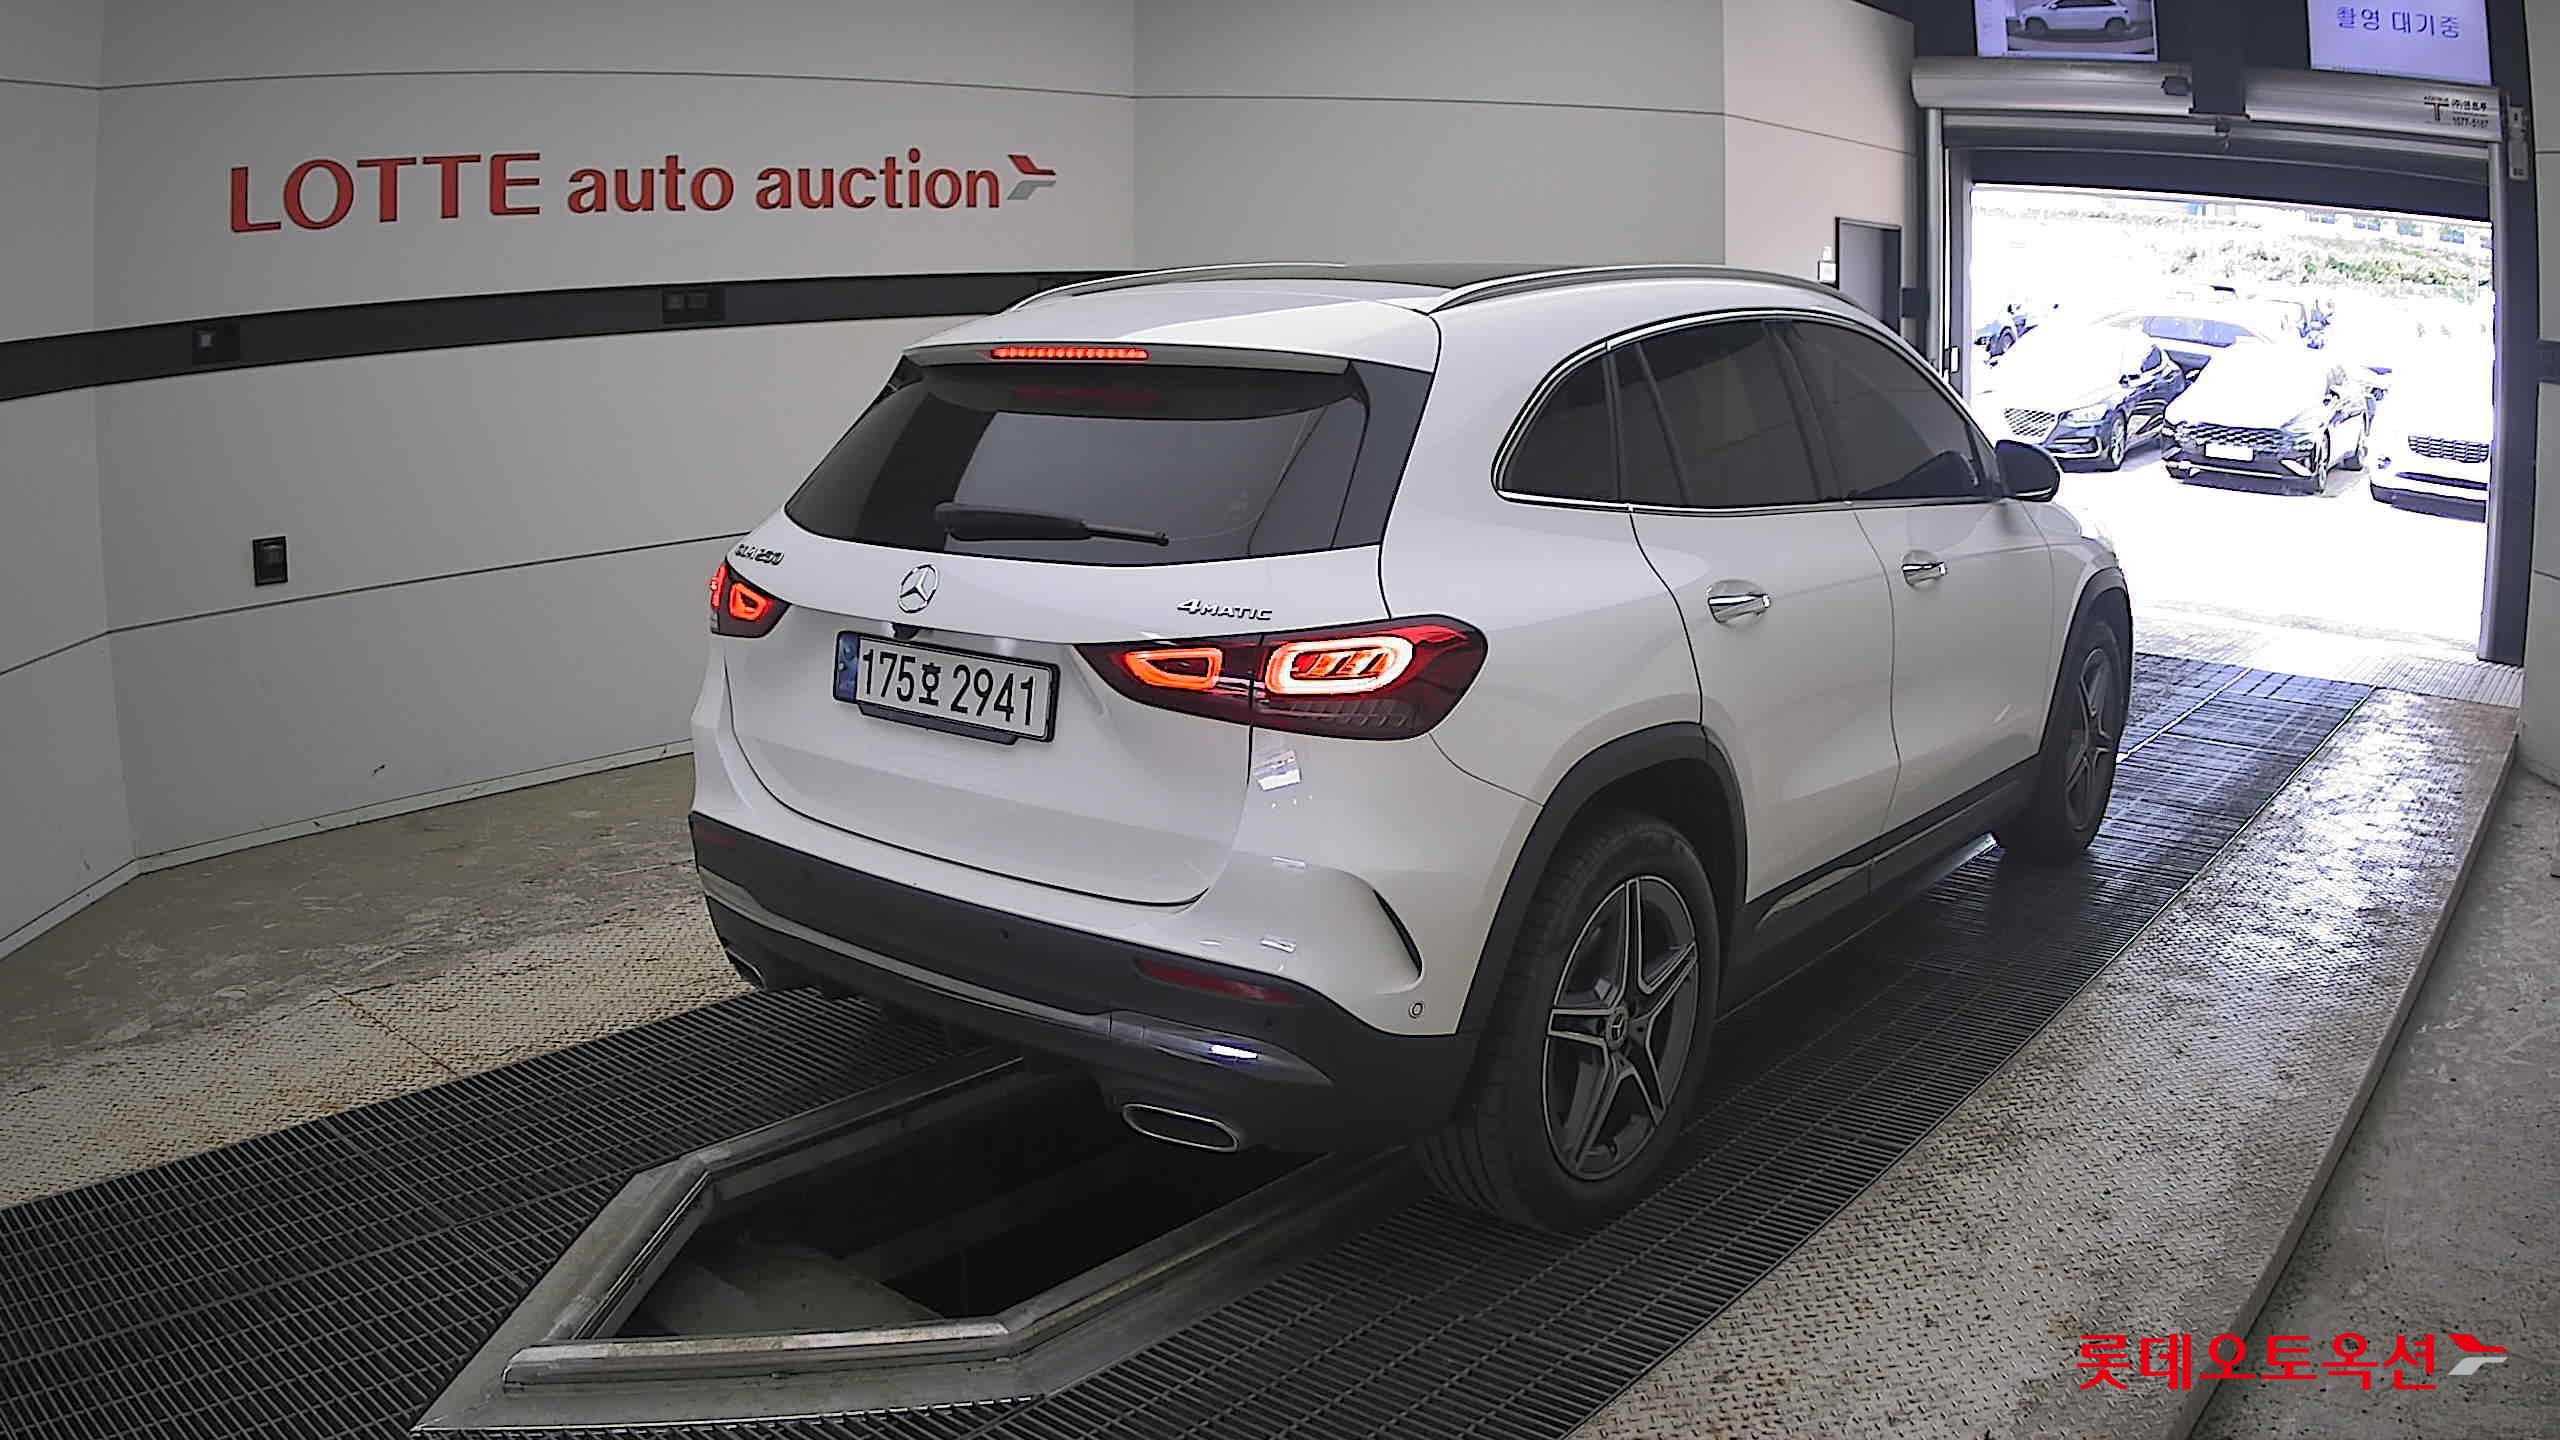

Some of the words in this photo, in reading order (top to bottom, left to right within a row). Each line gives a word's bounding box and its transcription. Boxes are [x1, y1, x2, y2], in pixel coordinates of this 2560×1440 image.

[2336, 6, 2381, 32] 촬영
[2391, 10, 2461, 39] 대기중
[231, 152, 541, 233] LOTTE
[567, 154, 736, 214] auto
[755, 148, 1003, 211] auction
[1176, 598, 1273, 621] 4MATIC
[862, 648, 942, 706] 175호
[950, 663, 1037, 727] 2941
